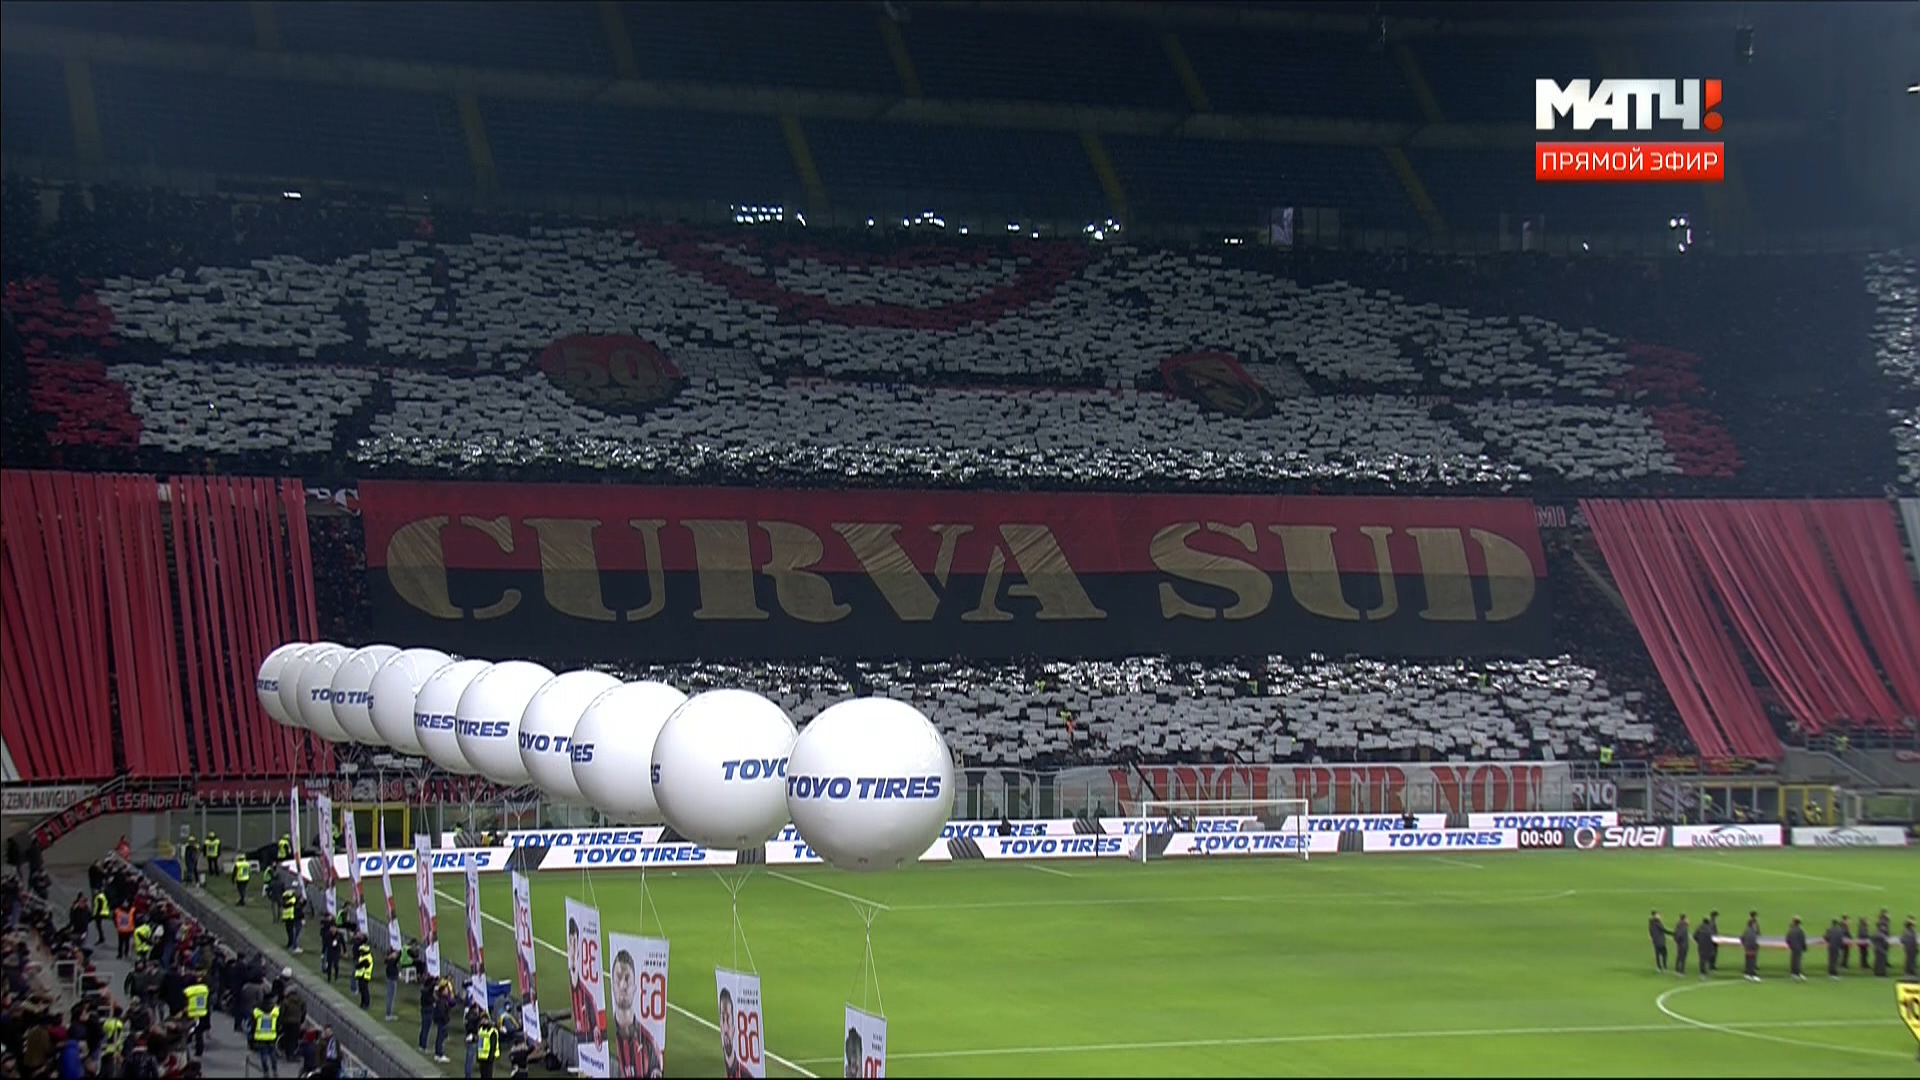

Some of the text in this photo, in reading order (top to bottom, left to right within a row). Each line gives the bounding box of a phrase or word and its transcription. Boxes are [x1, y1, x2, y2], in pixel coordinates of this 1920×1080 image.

[387, 516, 1536, 623] CURVA SUD
[458, 719, 510, 737] TIRES
[788, 775, 942, 800] TOYO TIRES
[100, 792, 190, 811] ALESSANDRIA
[1307, 818, 1360, 832] TOYO
[1492, 816, 1546, 829] TOYO
[1549, 815, 1603, 828] TIRES
[511, 831, 643, 848] TOYO TIRES
[1000, 837, 1122, 854] TOYO TIRES
[1193, 834, 1312, 850] TOYO TIRES
[1388, 832, 1503, 847] TOYO TIRES
[1520, 830, 1563, 846] 00:00
[1691, 834, 1736, 847] BANCO
[573, 846, 706, 864] TOYO TIRES
